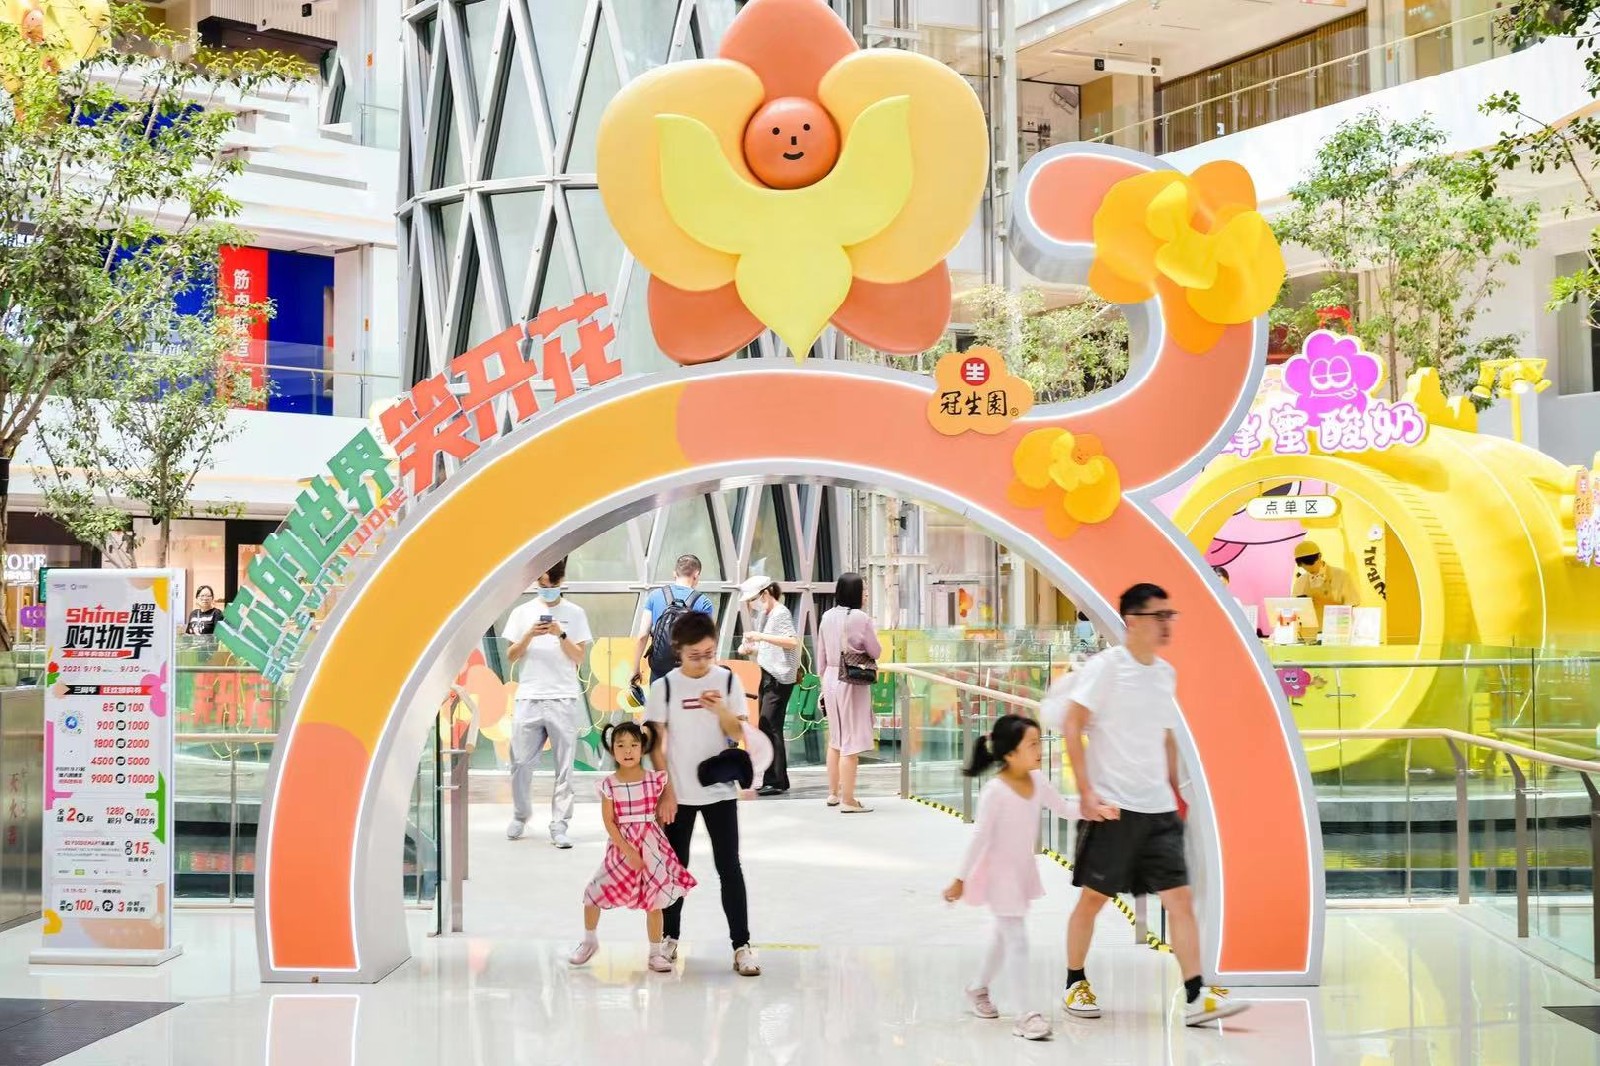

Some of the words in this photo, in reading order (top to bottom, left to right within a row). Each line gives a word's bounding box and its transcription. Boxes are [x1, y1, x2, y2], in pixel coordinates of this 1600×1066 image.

[1265, 500, 1318, 514] 点单区
[62, 625, 154, 659] 购物季
[103, 703, 115, 712] 85
[128, 703, 144, 712] 100
[97, 721, 114, 730] 900
[128, 721, 149, 730] 1000
[94, 739, 114, 748] 1800
[127, 739, 149, 748] 2000
[91, 757, 114, 765] 4500
[127, 757, 150, 765] 5000
[91, 774, 113, 783] 9000
[128, 774, 155, 783] 10000
[66, 807, 76, 822] 2
[106, 807, 125, 816] 1280
[136, 808, 150, 816] 100
[134, 842, 149, 854] 15
[76, 900, 93, 911] 100
